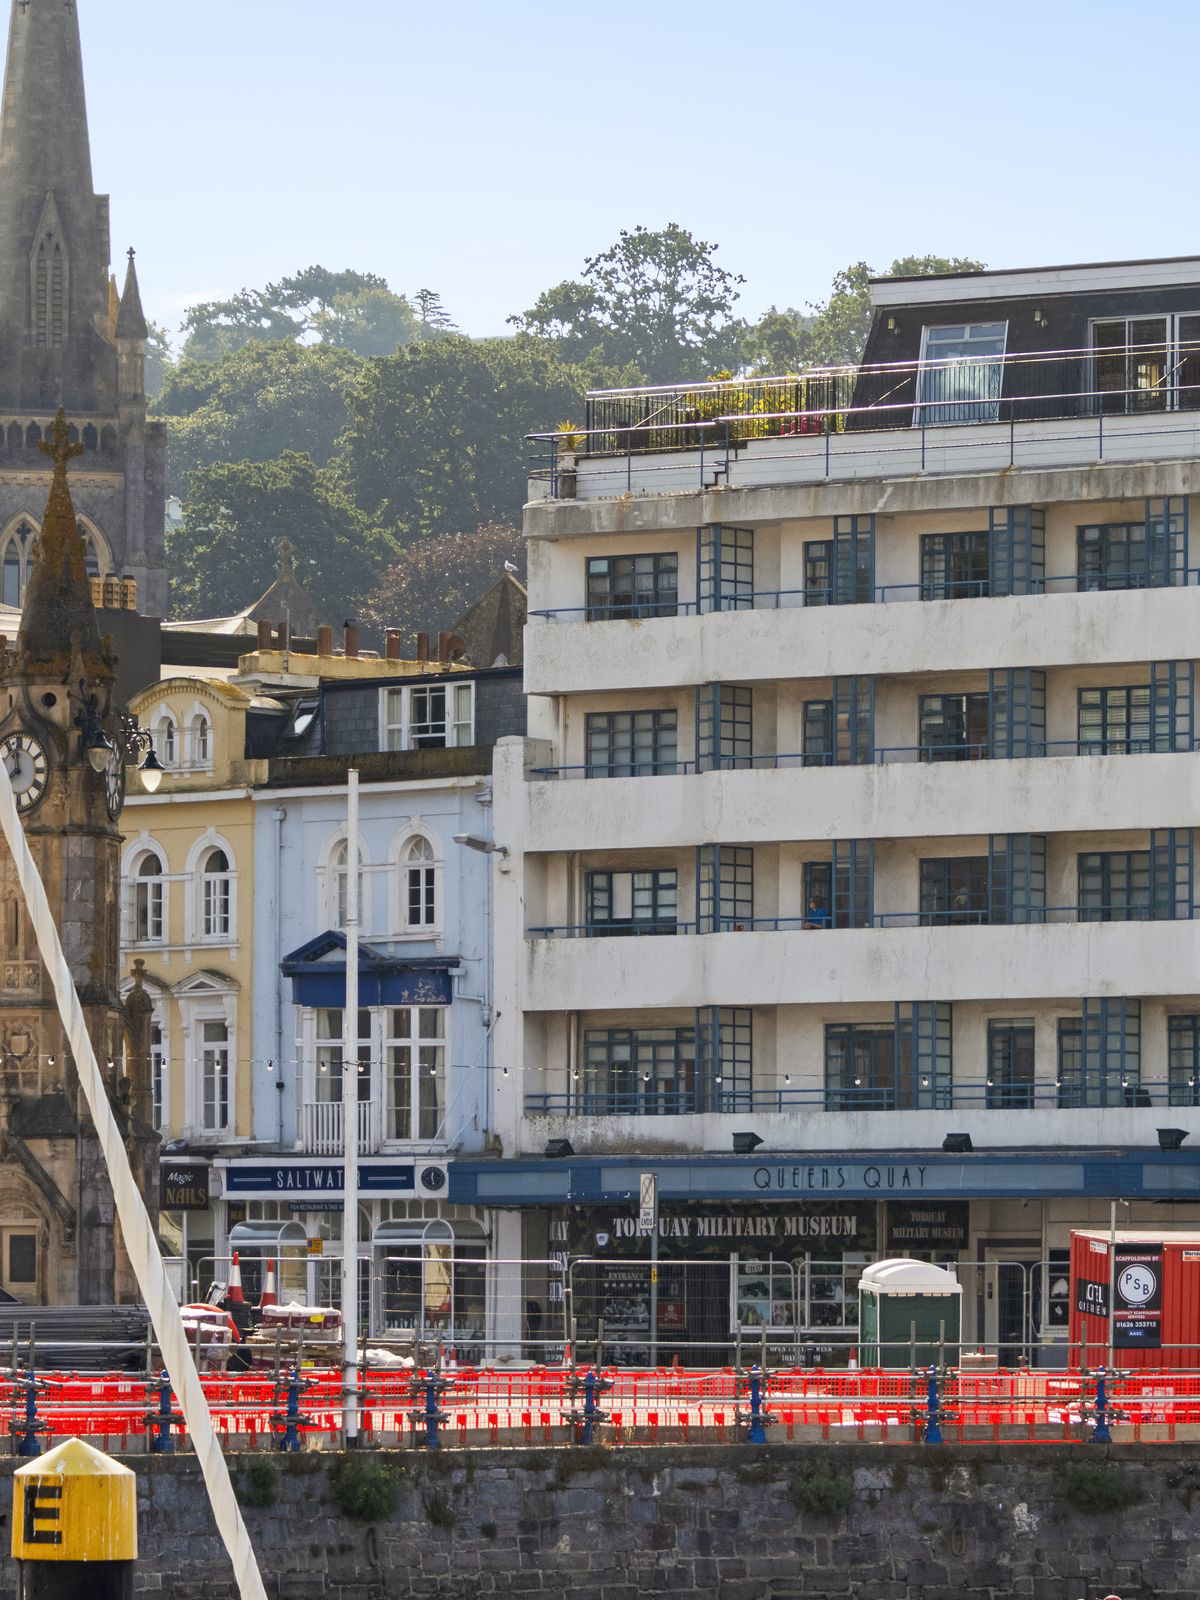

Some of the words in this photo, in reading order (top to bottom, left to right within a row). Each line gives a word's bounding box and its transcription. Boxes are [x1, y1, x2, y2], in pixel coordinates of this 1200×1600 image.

[167, 1172, 194, 1184] Magic
[276, 1170, 361, 1188] SALTWAT
[754, 1167, 845, 1189] QUEENS
[863, 1167, 927, 1188] QUAY
[166, 1188, 206, 1204] NAILS
[910, 1211, 946, 1223] TORQUAY
[698, 1217, 778, 1237] MILITARY
[784, 1216, 857, 1236] MUSEUM
[893, 1227, 929, 1239] MILITARY
[931, 1227, 964, 1239] MUSEUM
[608, 1272, 645, 1280] ENTRANCE
[24, 1485, 62, 1544] E
